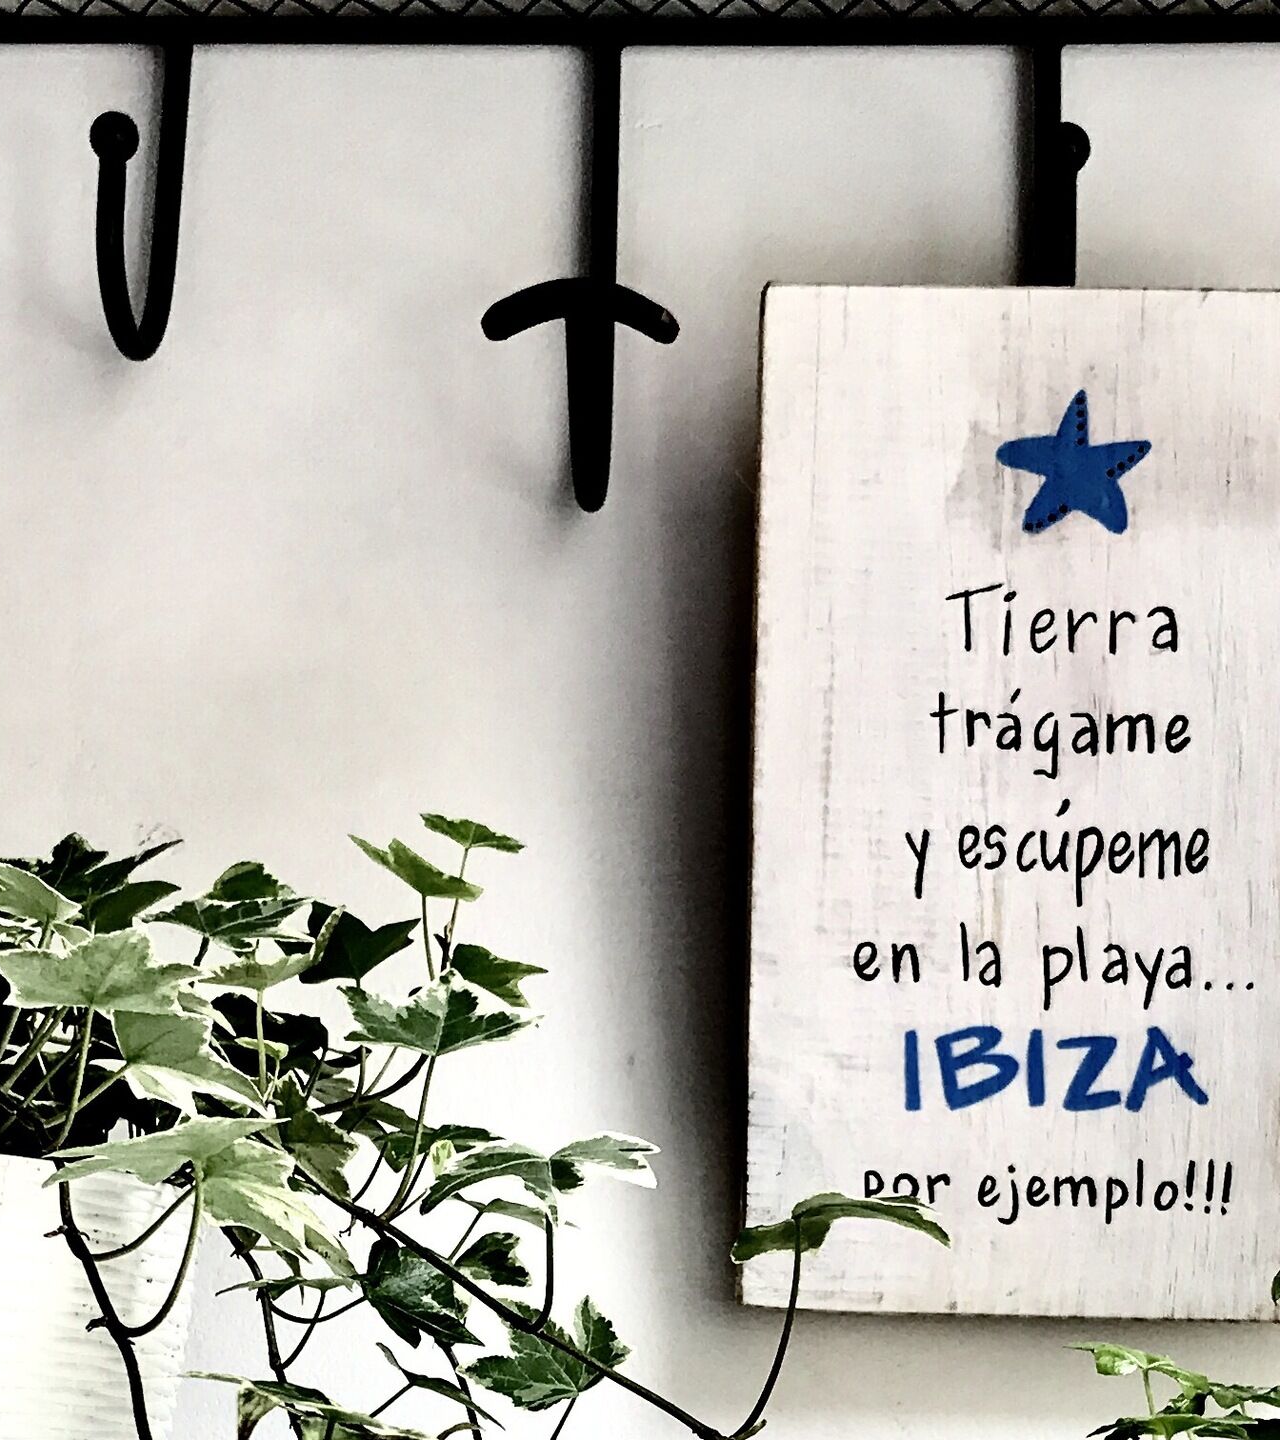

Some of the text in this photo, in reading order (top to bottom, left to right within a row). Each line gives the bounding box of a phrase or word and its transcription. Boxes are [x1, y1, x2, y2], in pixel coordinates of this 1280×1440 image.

[945, 583, 1179, 657] Tierra
[929, 688, 1192, 780] trágame
[905, 798, 1210, 908] y escúpeme
[853, 921, 1255, 1011] en la playa...
[904, 1025, 1210, 1113] IBIZA
[976, 1158, 1233, 1226] ejemplo!!!
